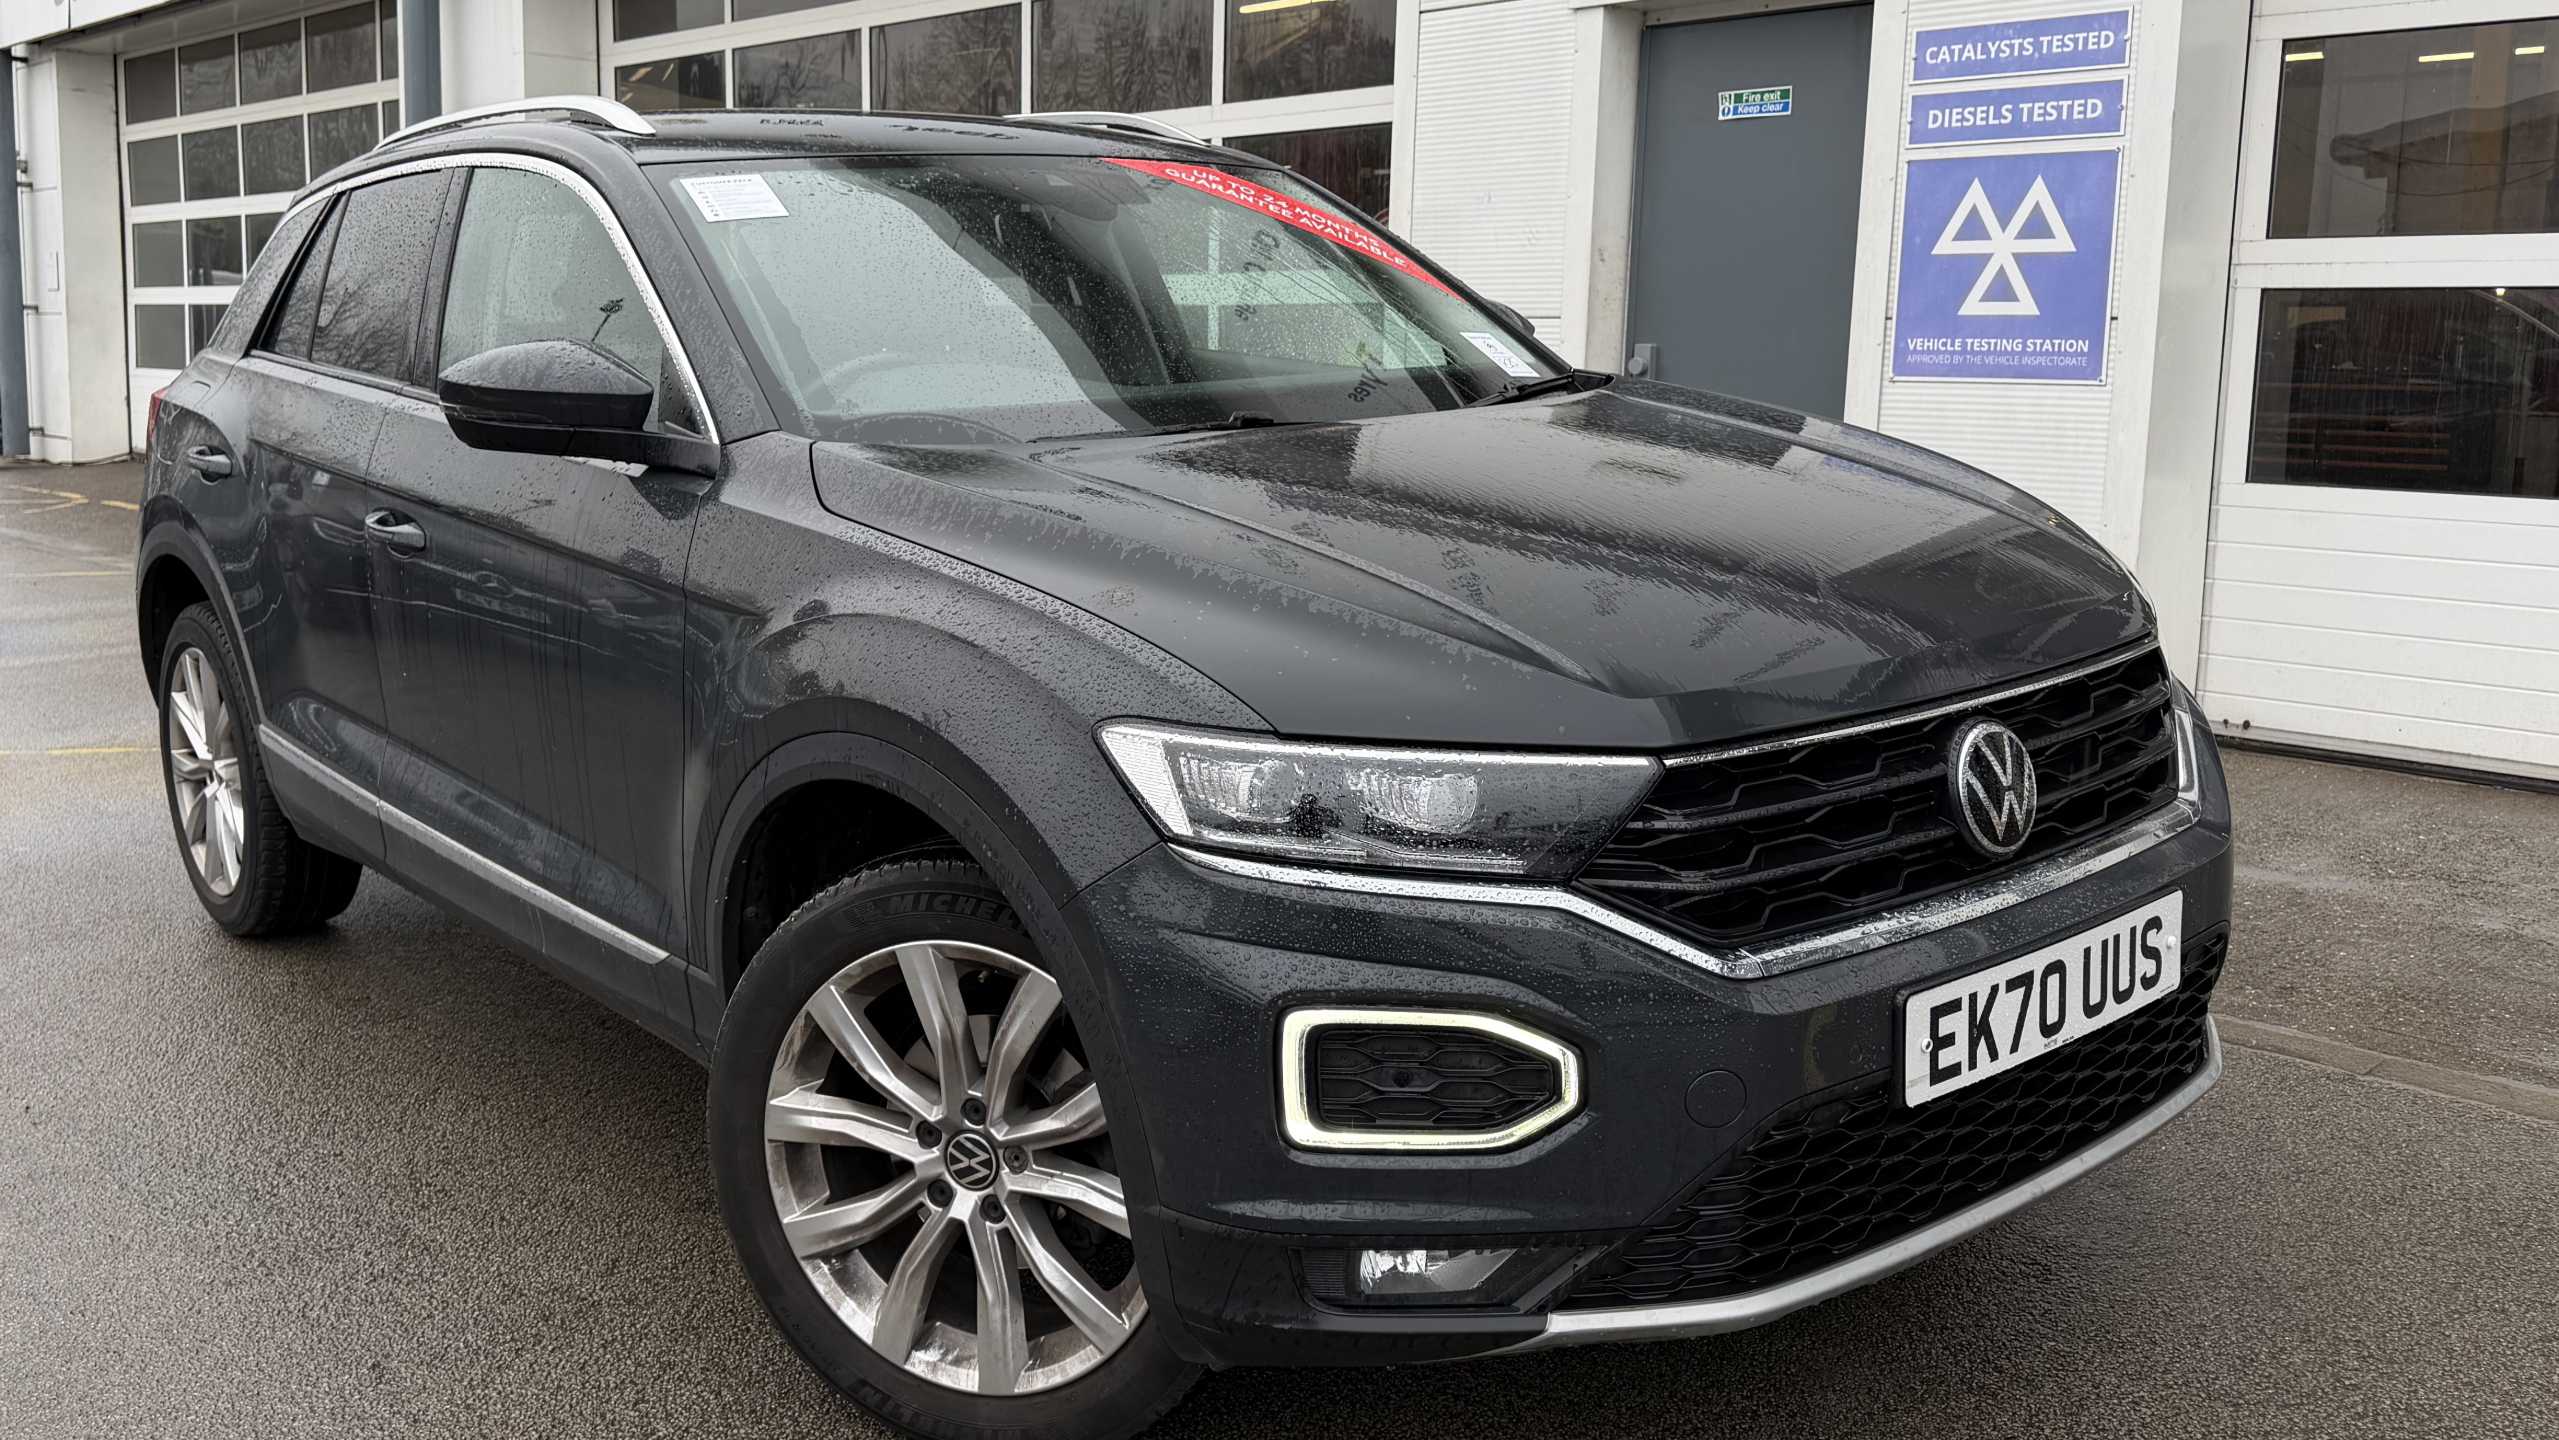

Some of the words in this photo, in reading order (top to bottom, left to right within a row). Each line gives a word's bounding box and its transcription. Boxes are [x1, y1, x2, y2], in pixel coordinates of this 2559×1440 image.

[1925, 38, 2034, 64] CATALYSTS
[2039, 30, 2115, 54] TESTED
[1738, 105, 1760, 114] Keep
[1762, 103, 1784, 112] clear
[1743, 93, 1760, 103] Fire
[1763, 91, 1781, 101] exit
[1927, 103, 2013, 129] DIESELS
[2019, 98, 2103, 122] TESTED
[1165, 168, 1294, 219] GUARANTEE
[1300, 217, 1407, 265] AVAILABLE
[1192, 169, 1221, 182] UP
[1230, 182, 1256, 195] TO
[1264, 195, 1289, 208] 24
[1295, 207, 1385, 246] MONTHS
[1906, 354, 1951, 365] APPROVED
[1953, 354, 1963, 365] BY
[1965, 354, 1982, 365] THE
[1983, 355, 2020, 366] VEHICLE
[2022, 355, 2088, 367] INSPECTORATE
[1907, 338, 1962, 351] VEHICLE
[1965, 338, 2023, 352] TESTING
[2026, 339, 2089, 354] STATION
[1930, 959, 2067, 1088] EK70
[2083, 915, 2163, 1019] UUS
